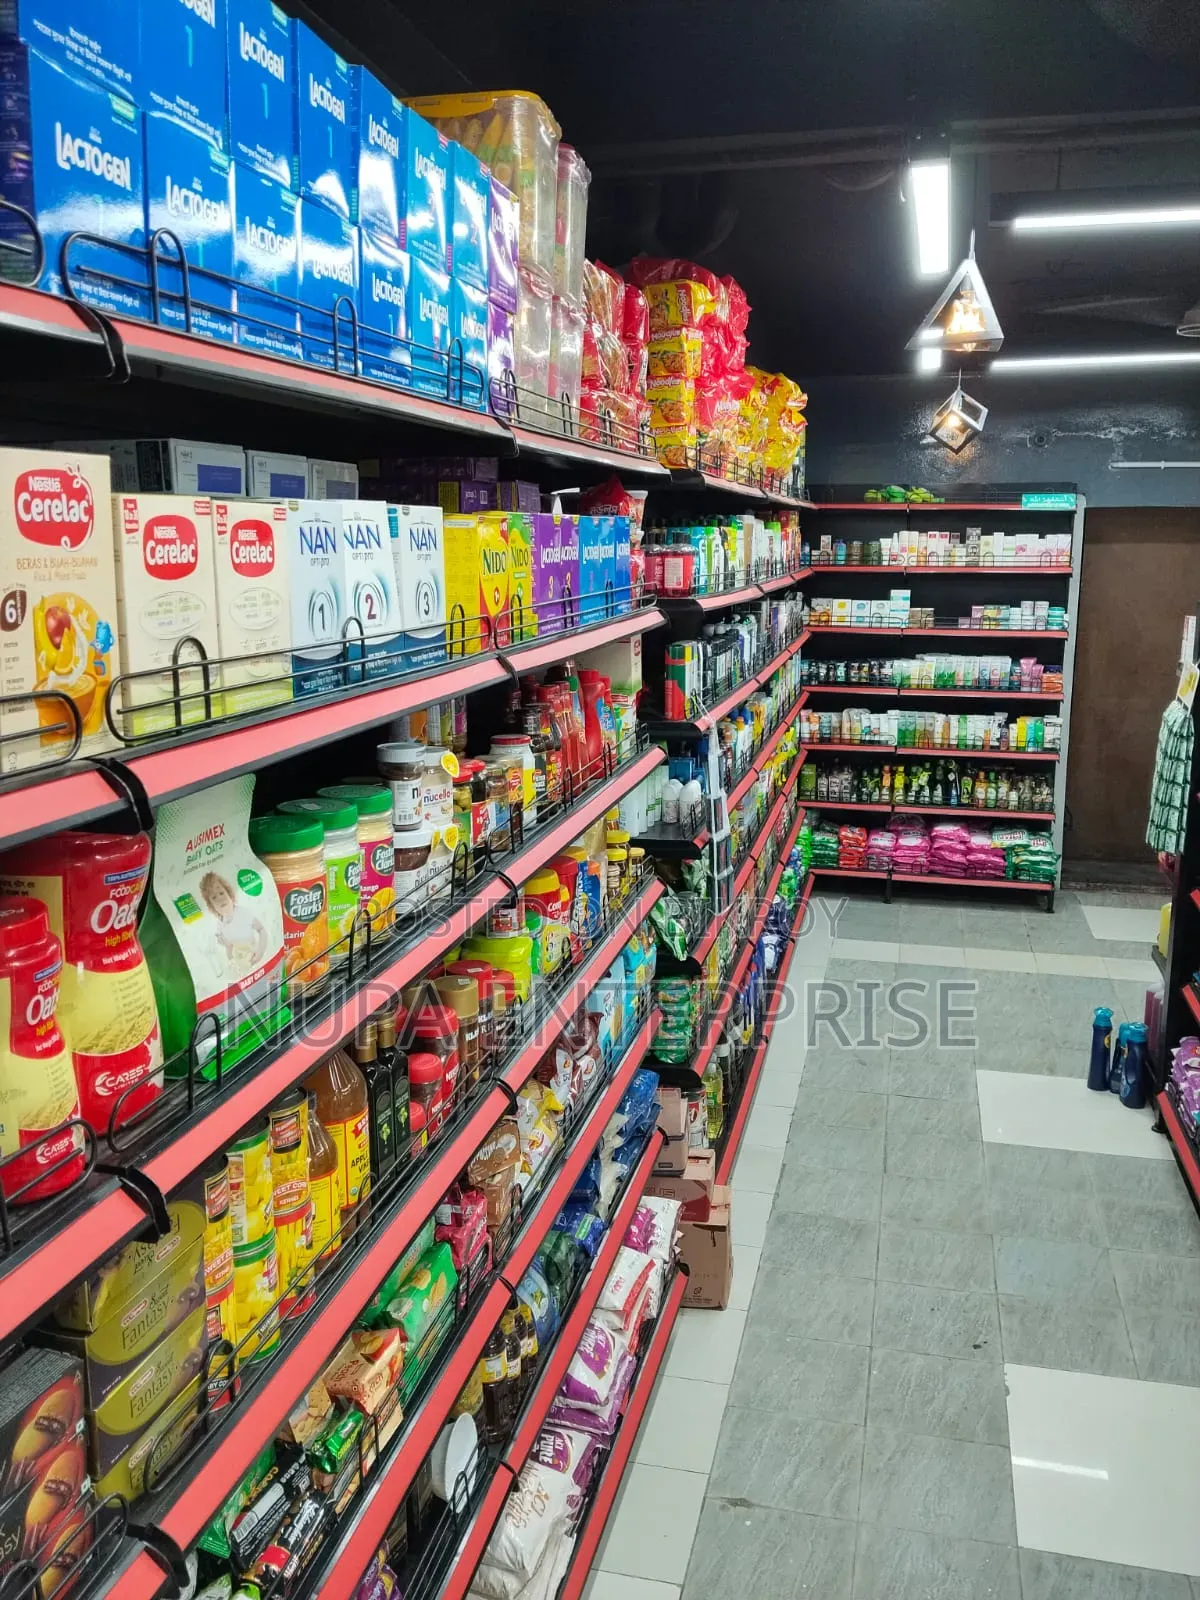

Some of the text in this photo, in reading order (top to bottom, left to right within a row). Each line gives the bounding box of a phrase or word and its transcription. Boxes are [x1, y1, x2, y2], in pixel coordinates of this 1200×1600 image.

[240, 21, 285, 83] LACTOGEN
[309, 73, 346, 124] LACTOGEN
[369, 113, 399, 160] LACTOGEN
[55, 121, 132, 191] LACTOGEN
[165, 175, 228, 222] LACTOGEN
[313, 257, 355, 289] LACTOGEN
[372, 272, 405, 309] LACTOGEN
[419, 293, 449, 328] LACTOGEN
[17, 491, 91, 523] Cerelac
[146, 539, 196, 567] Cerelac
[299, 526, 337, 555] NAN
[409, 527, 438, 552] NAN
[17, 558, 42, 571] BERAS
[231, 542, 273, 567] Cerelac
[482, 548, 507, 576] NIDO
[510, 545, 530, 570] NIDO
[5, 599, 17, 623] 6
[365, 593, 377, 620] 2
[424, 592, 431, 616] 3
[186, 823, 226, 853] AUSIMEX
[290, 890, 322, 906] Foster
[105, 1065, 145, 1089] CARES
[43, 1140, 70, 1157] CARES
[122, 1302, 169, 1350] Fantasy
[129, 1367, 175, 1419] Fantasy
[539, 1432, 554, 1467] PURE
[555, 1435, 564, 1453] ACI
